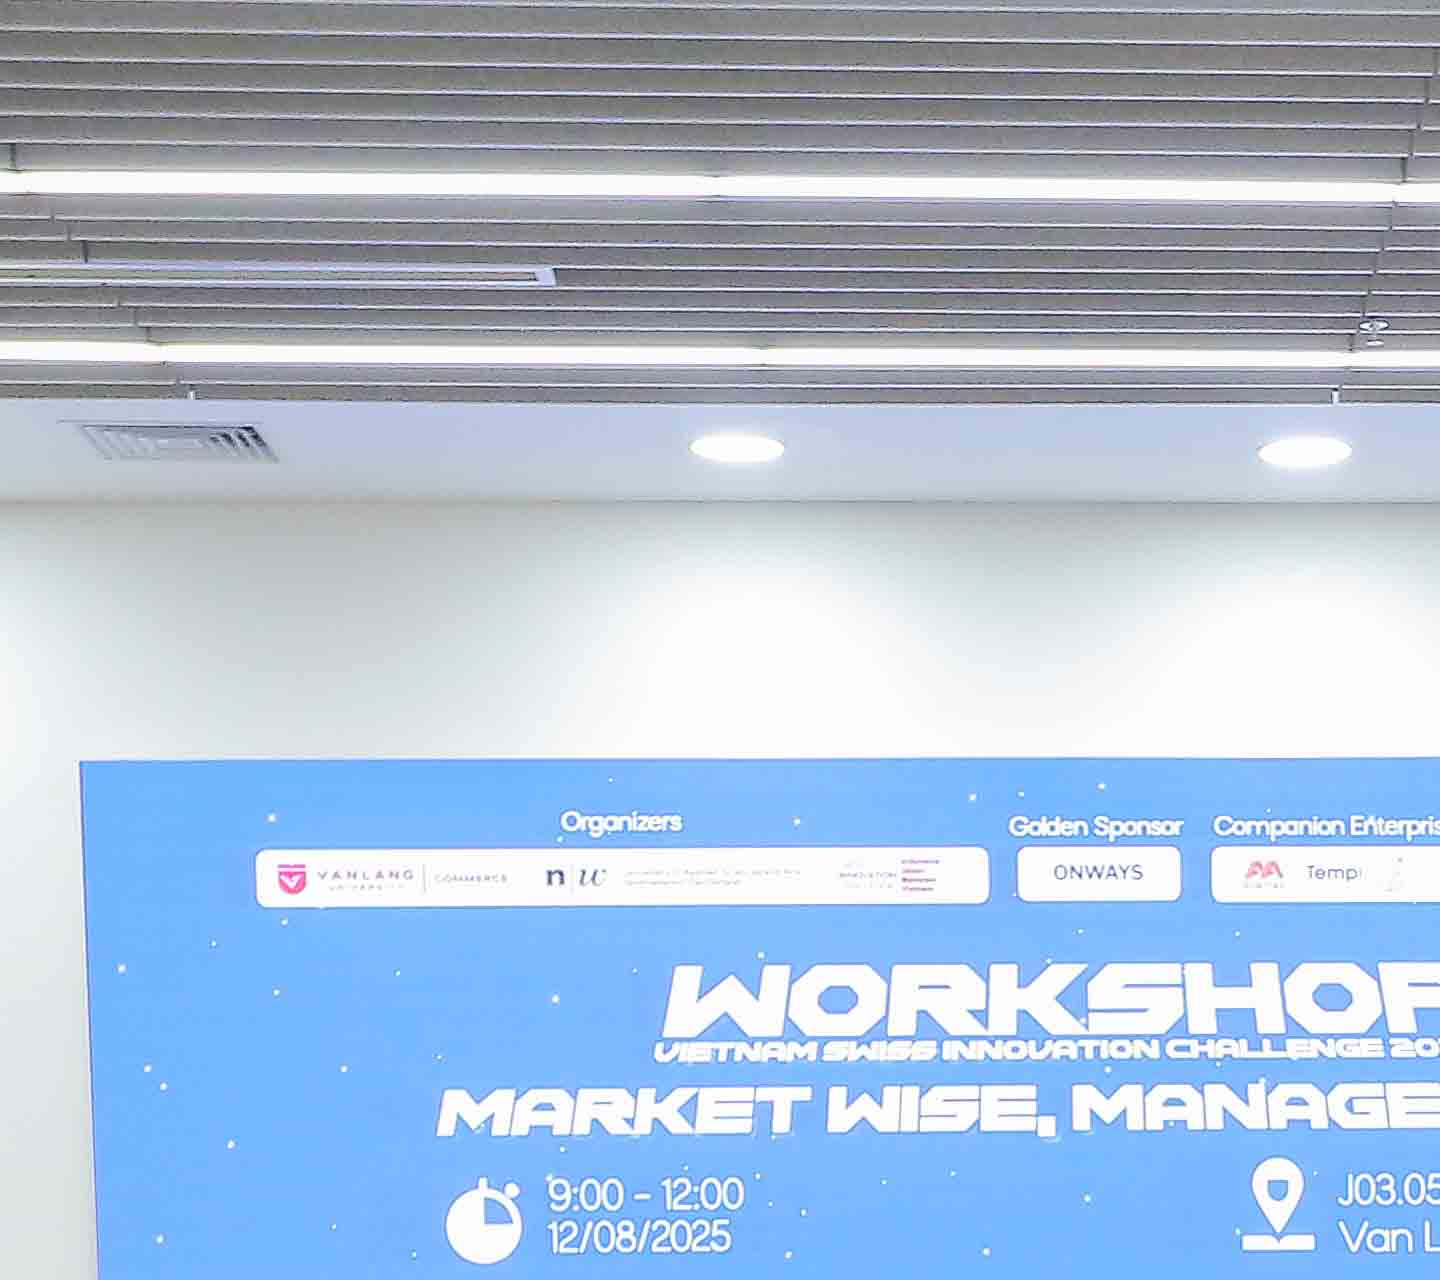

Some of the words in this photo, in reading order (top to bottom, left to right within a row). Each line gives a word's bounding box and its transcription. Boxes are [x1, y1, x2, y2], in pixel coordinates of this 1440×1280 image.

[560, 808, 684, 838] Organizers
[1008, 814, 1088, 837] Golden
[1093, 815, 1185, 842] Sponsor
[1213, 814, 1345, 842] Companion
[1053, 863, 1144, 881] ONWAYS
[653, 1037, 819, 1064] VIETNAM
[821, 1037, 937, 1063] SWISS
[942, 1037, 1161, 1062] INNOVATION
[1164, 1036, 1386, 1061] CHALLENGE
[435, 1086, 813, 1137] MARKET
[826, 1084, 1057, 1138] WISE,
[547, 1178, 624, 1213] 9:00
[660, 1177, 745, 1213] 12:00
[547, 1219, 733, 1256] 12/08/2025
[1337, 1220, 1414, 1255] Van
